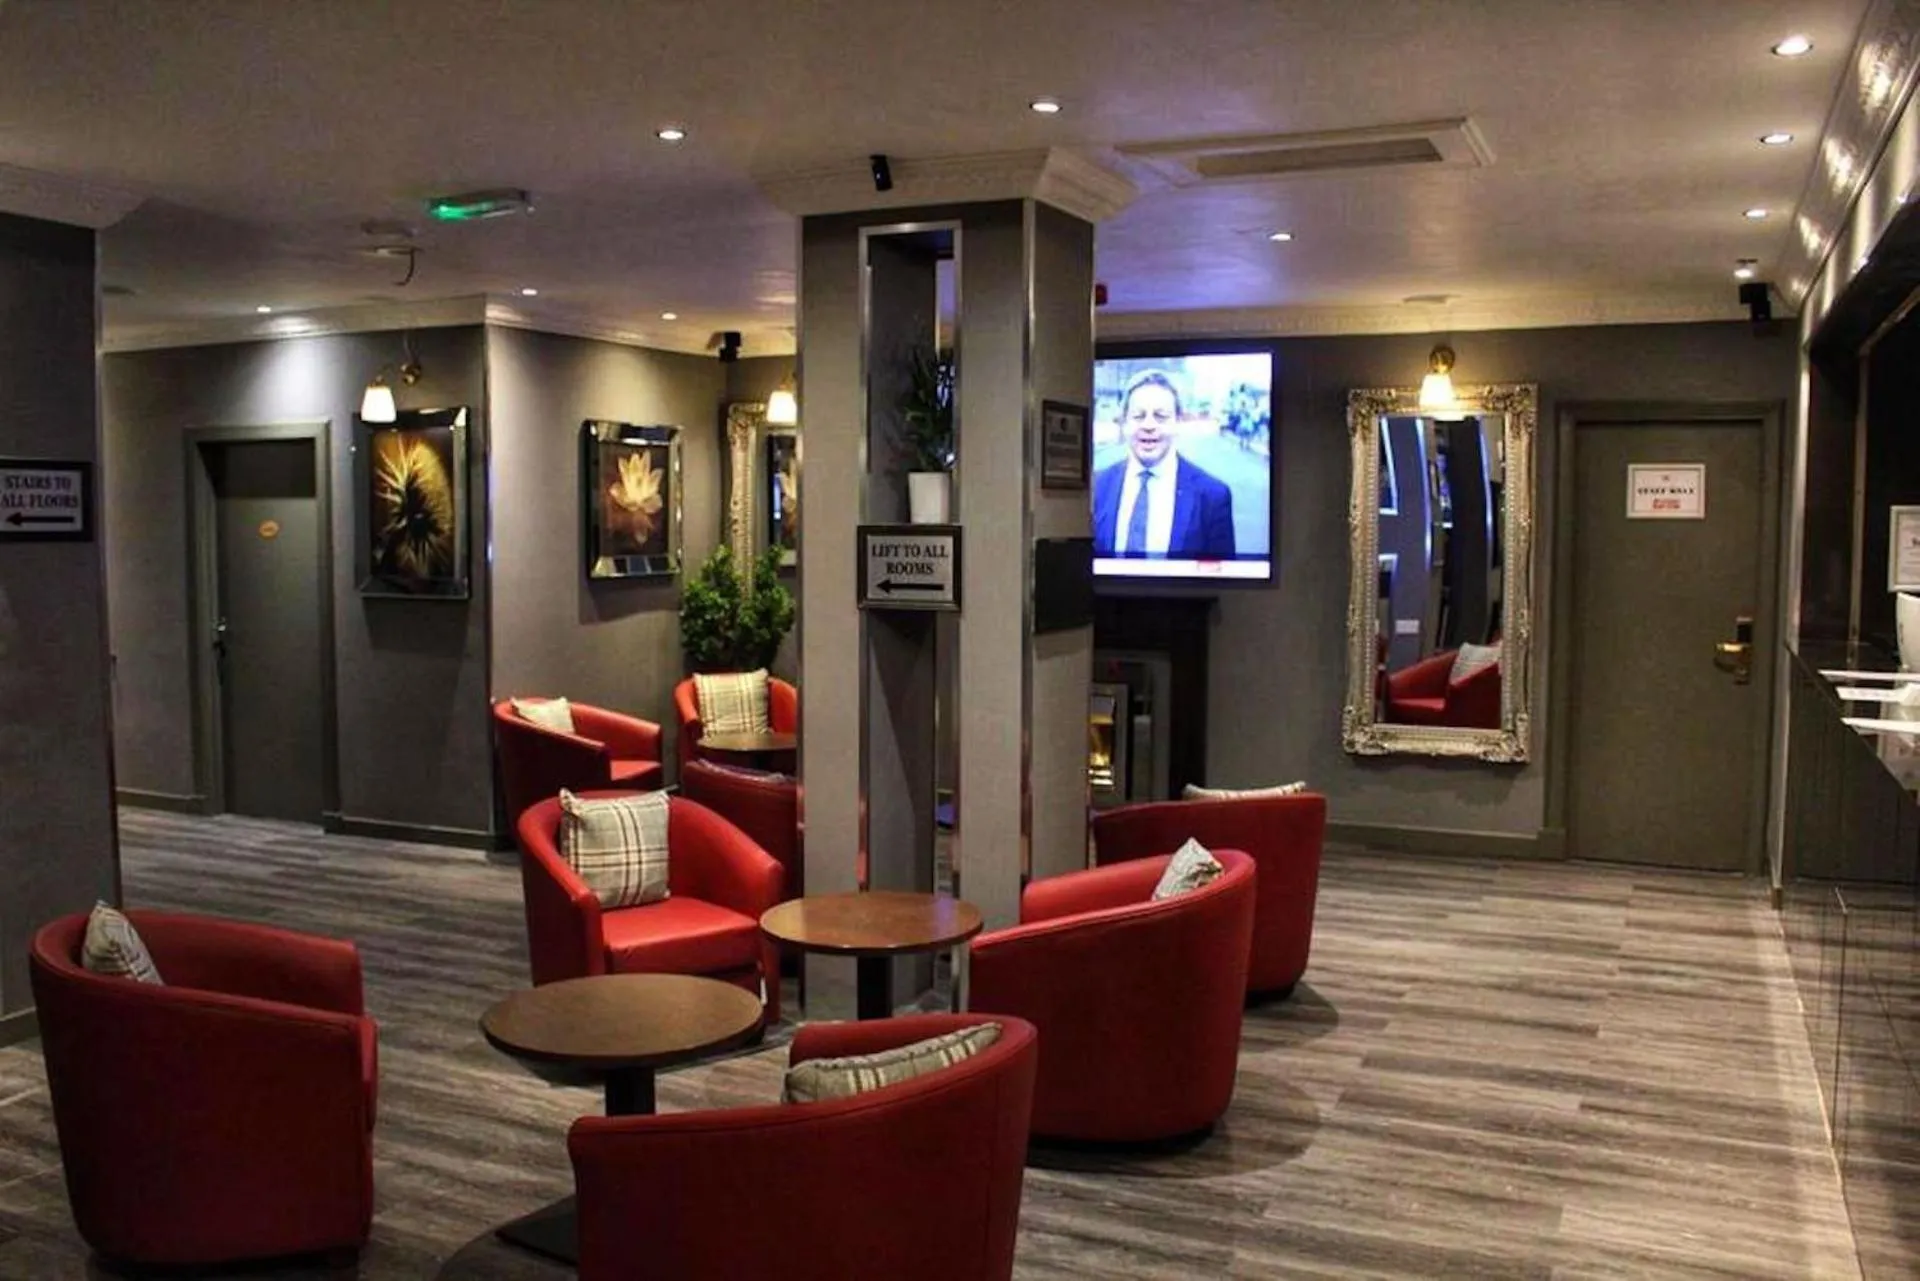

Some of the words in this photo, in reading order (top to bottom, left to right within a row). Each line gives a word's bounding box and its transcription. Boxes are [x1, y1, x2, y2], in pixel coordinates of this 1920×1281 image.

[5, 475, 51, 489] STAIRS
[53, 476, 72, 490] TO
[2, 493, 25, 508] ALL
[28, 494, 78, 509] FLOORS
[871, 544, 900, 557] LIFT
[903, 544, 920, 557] TO
[922, 544, 948, 557] ALL
[886, 562, 934, 575] ROOMS
